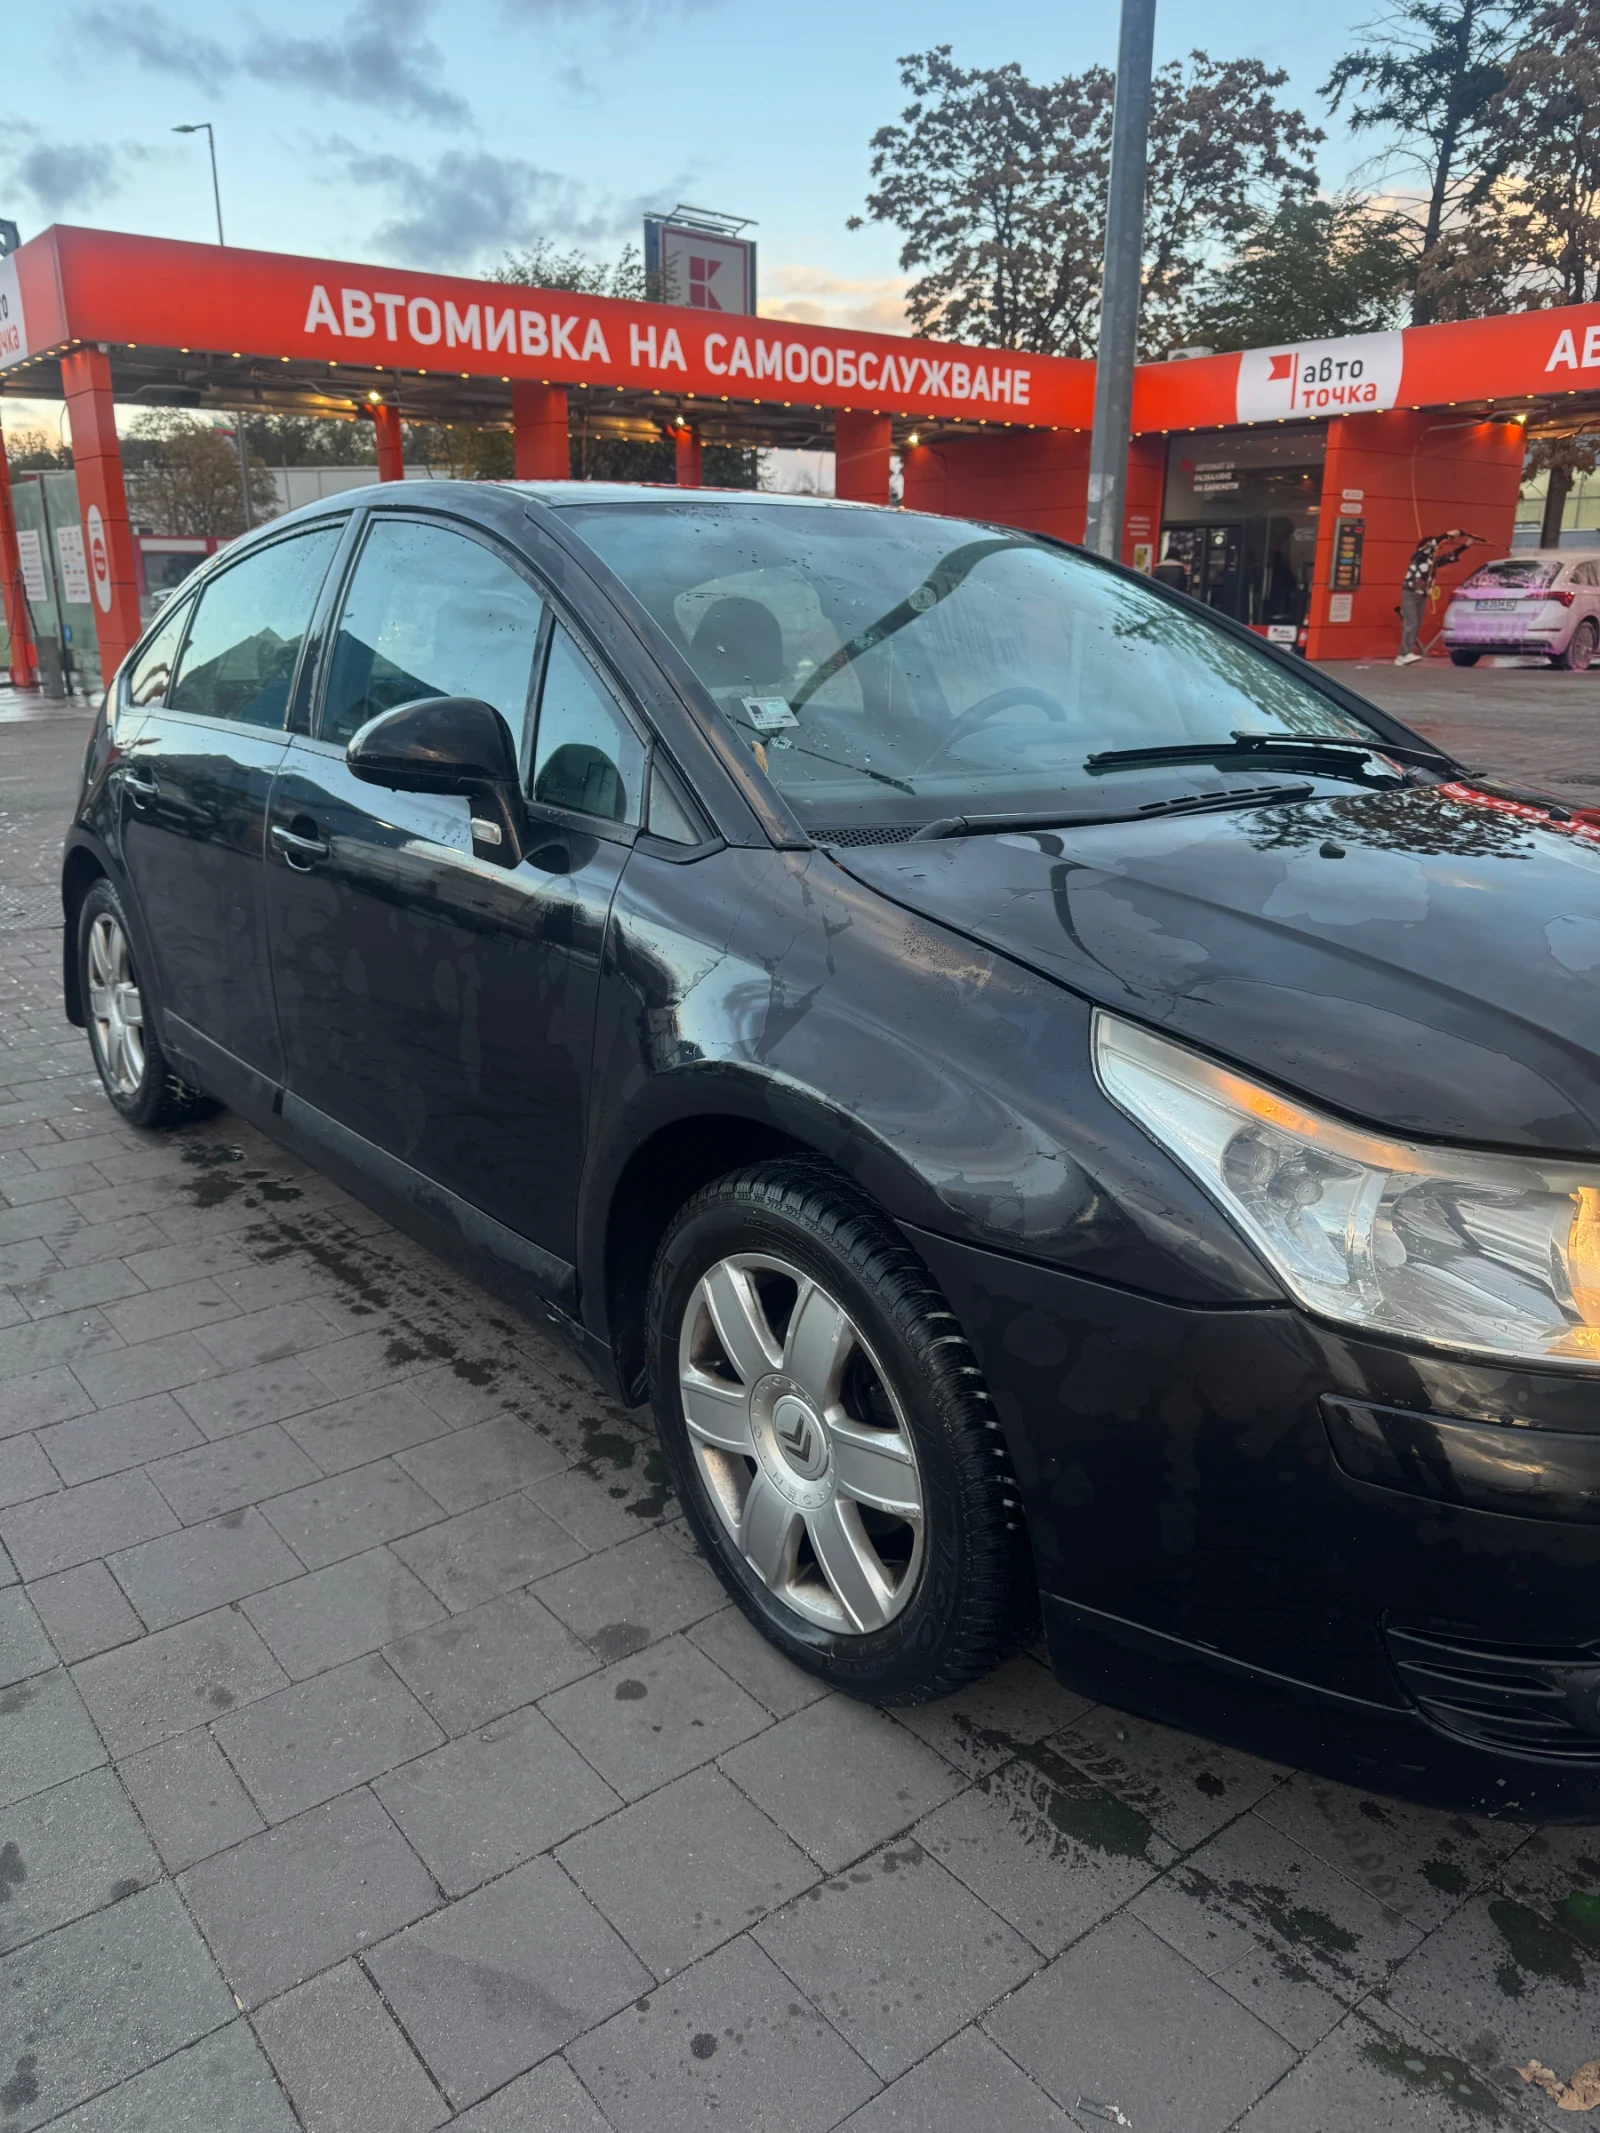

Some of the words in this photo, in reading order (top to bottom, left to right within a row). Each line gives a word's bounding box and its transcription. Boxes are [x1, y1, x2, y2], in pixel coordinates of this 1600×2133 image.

[304, 284, 612, 364] АВТОМИВКА
[629, 323, 687, 371] НА
[703, 333, 1031, 405] САМООБСЛУЖВАНЕ
[1303, 357, 1364, 383] авто
[1302, 383, 1377, 409] точка
